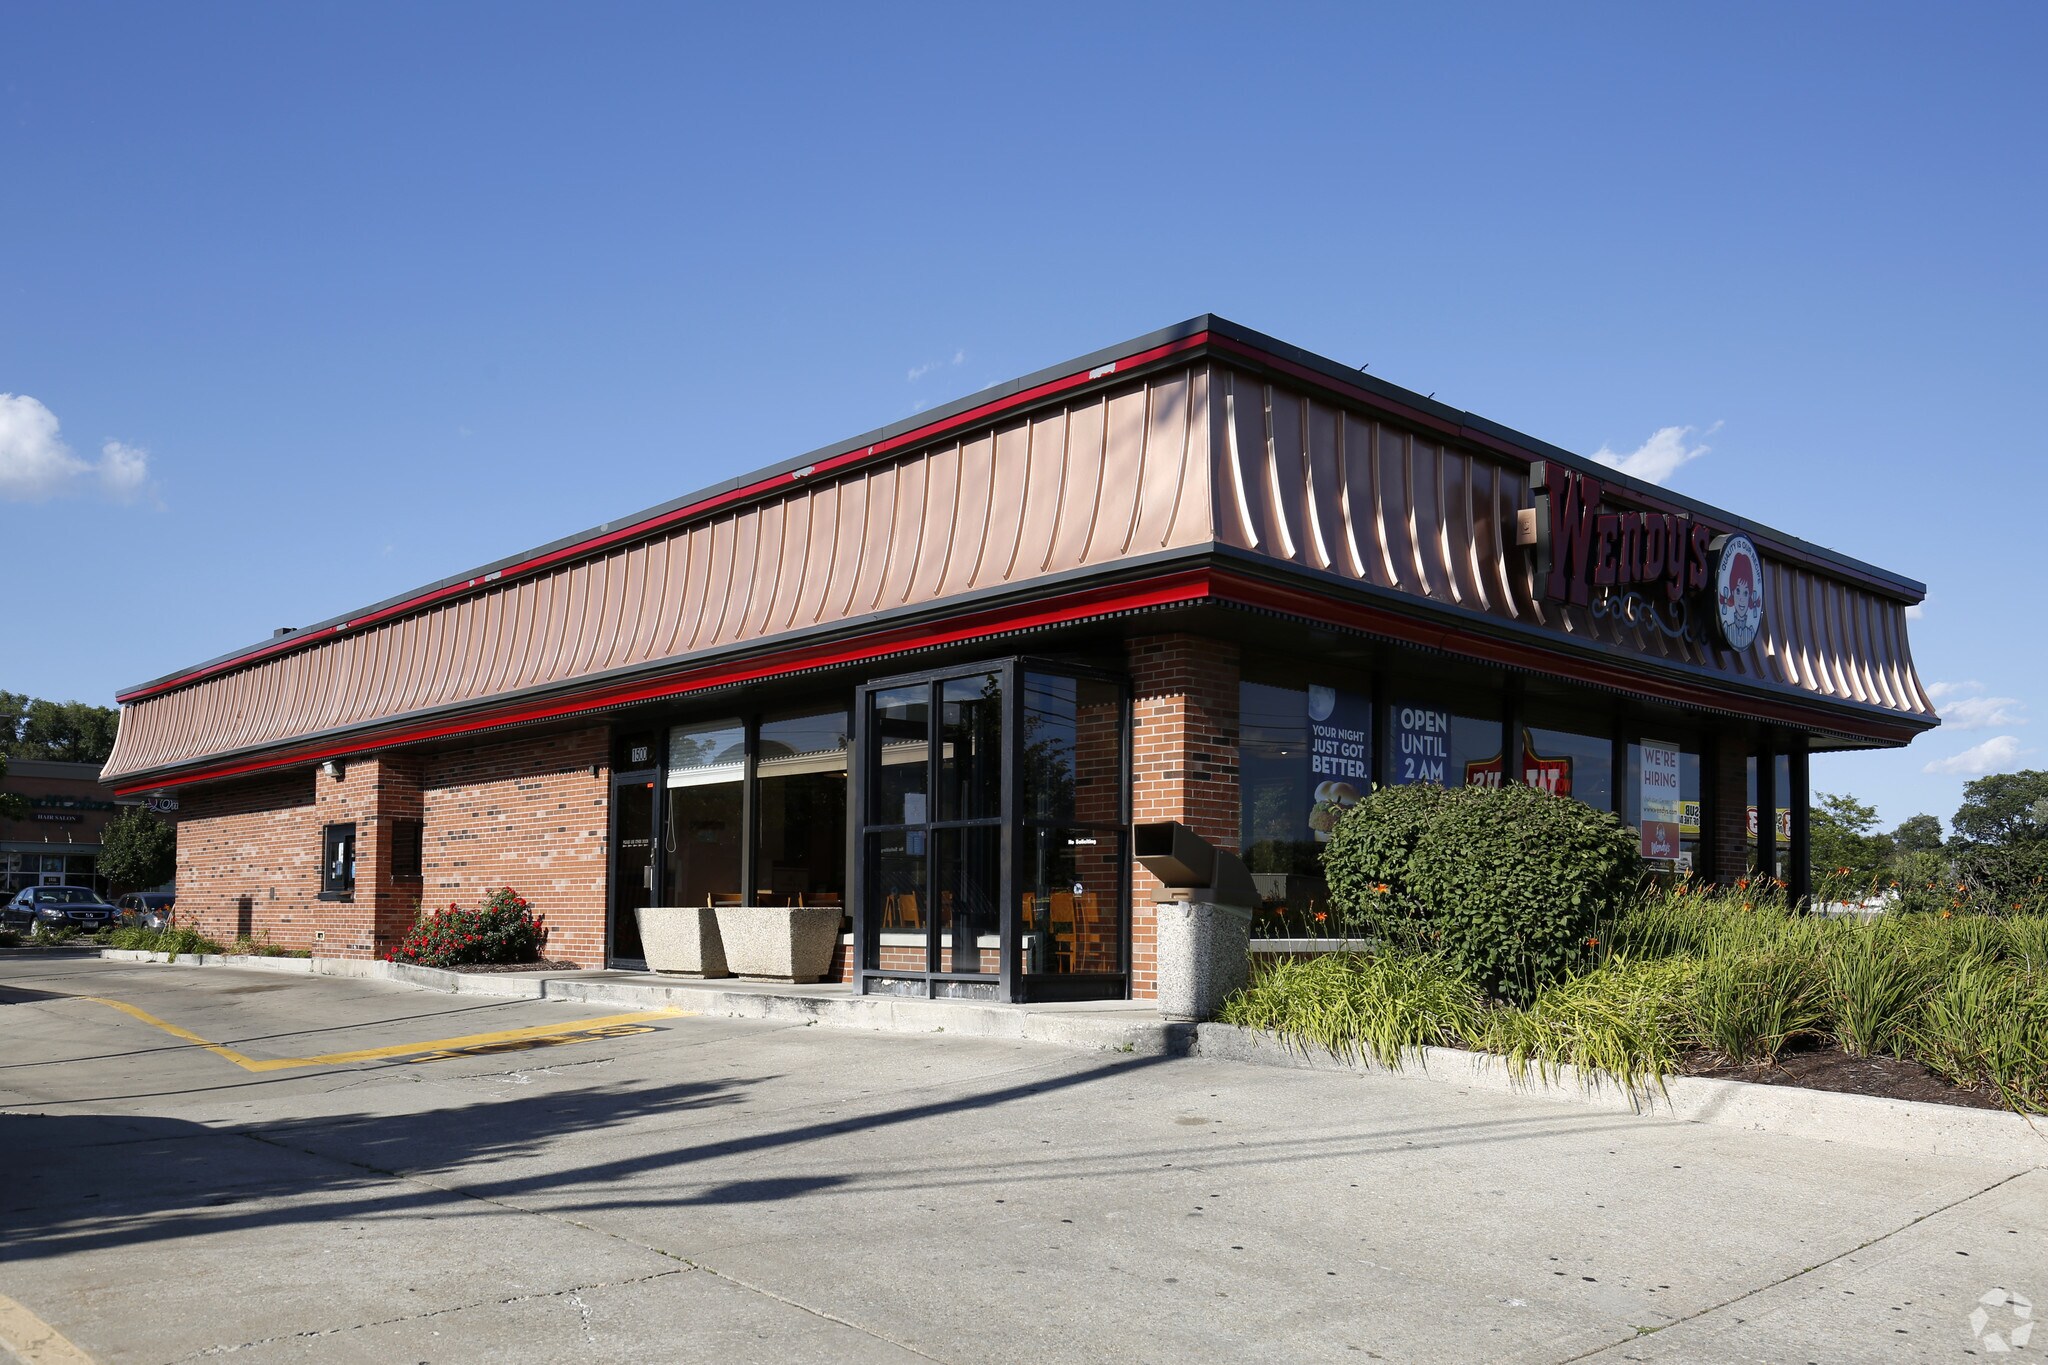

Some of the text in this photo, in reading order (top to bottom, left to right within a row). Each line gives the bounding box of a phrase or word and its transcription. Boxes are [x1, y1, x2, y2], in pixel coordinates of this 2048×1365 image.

[1721, 542, 1737, 572] QUALITY
[1742, 541, 1753, 556] OUR
[1751, 553, 1762, 585] RECIPE
[1400, 708, 1447, 733] OPEN
[1312, 725, 1365, 742] YOUR NIGHT
[632, 746, 648, 762] 1500
[1312, 739, 1365, 758] JUST GOT
[1401, 733, 1447, 758] UNTIL
[1312, 755, 1368, 779] BETTER.
[1644, 748, 1676, 768] WE'RE
[1404, 758, 1444, 781] 2 AM
[1644, 770, 1677, 788] HIRING
[37, 813, 77, 822] HAIR SALON
[1650, 840, 1671, 856] Wendy's
